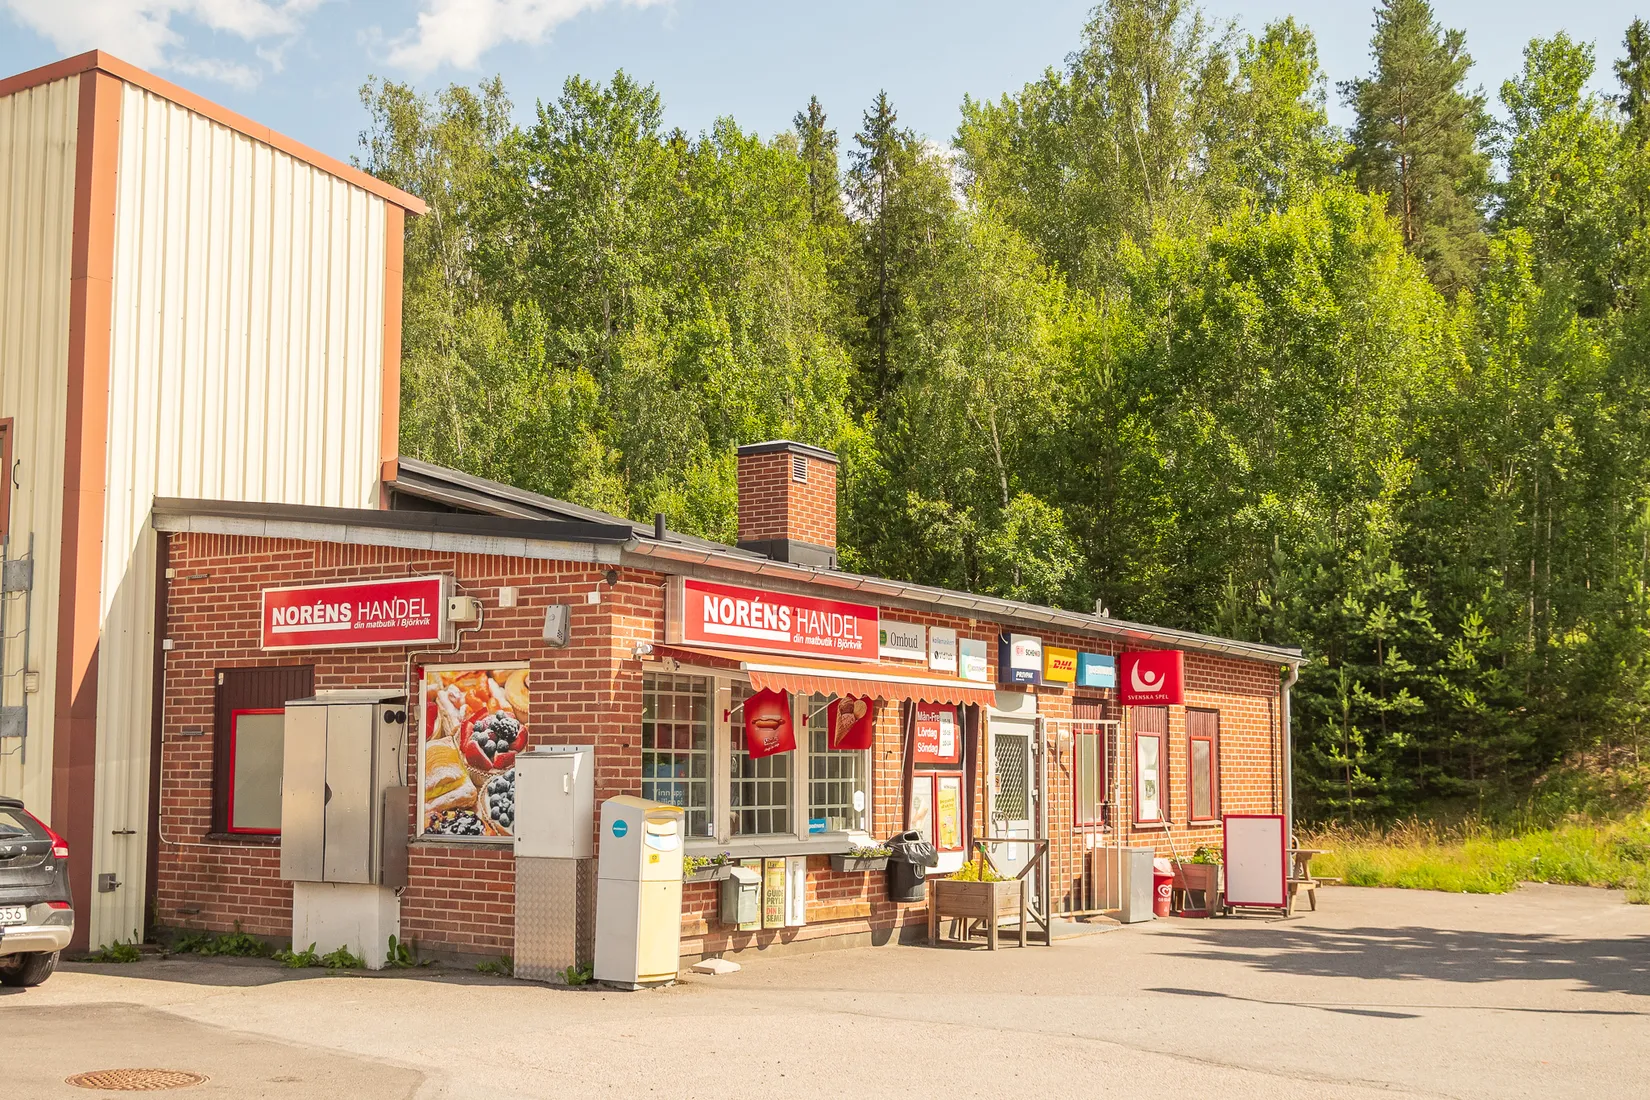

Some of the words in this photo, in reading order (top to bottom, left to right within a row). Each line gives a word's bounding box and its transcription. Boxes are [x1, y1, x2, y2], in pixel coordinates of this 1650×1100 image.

[272, 600, 352, 626] NORÉNS
[358, 596, 431, 621] HANDEL
[703, 595, 791, 632] NORÉNS
[796, 606, 863, 640] HANDEL
[354, 620, 365, 629] din
[366, 619, 397, 629] matbutik
[401, 617, 431, 628] Björkvik
[793, 633, 804, 644] din
[804, 635, 833, 648] matbutik
[837, 638, 863, 651] Björkvik
[890, 631, 919, 649] Ombud
[1052, 659, 1073, 671] DHL
[917, 726, 938, 740] Lördag
[917, 742, 939, 756] Söndag
